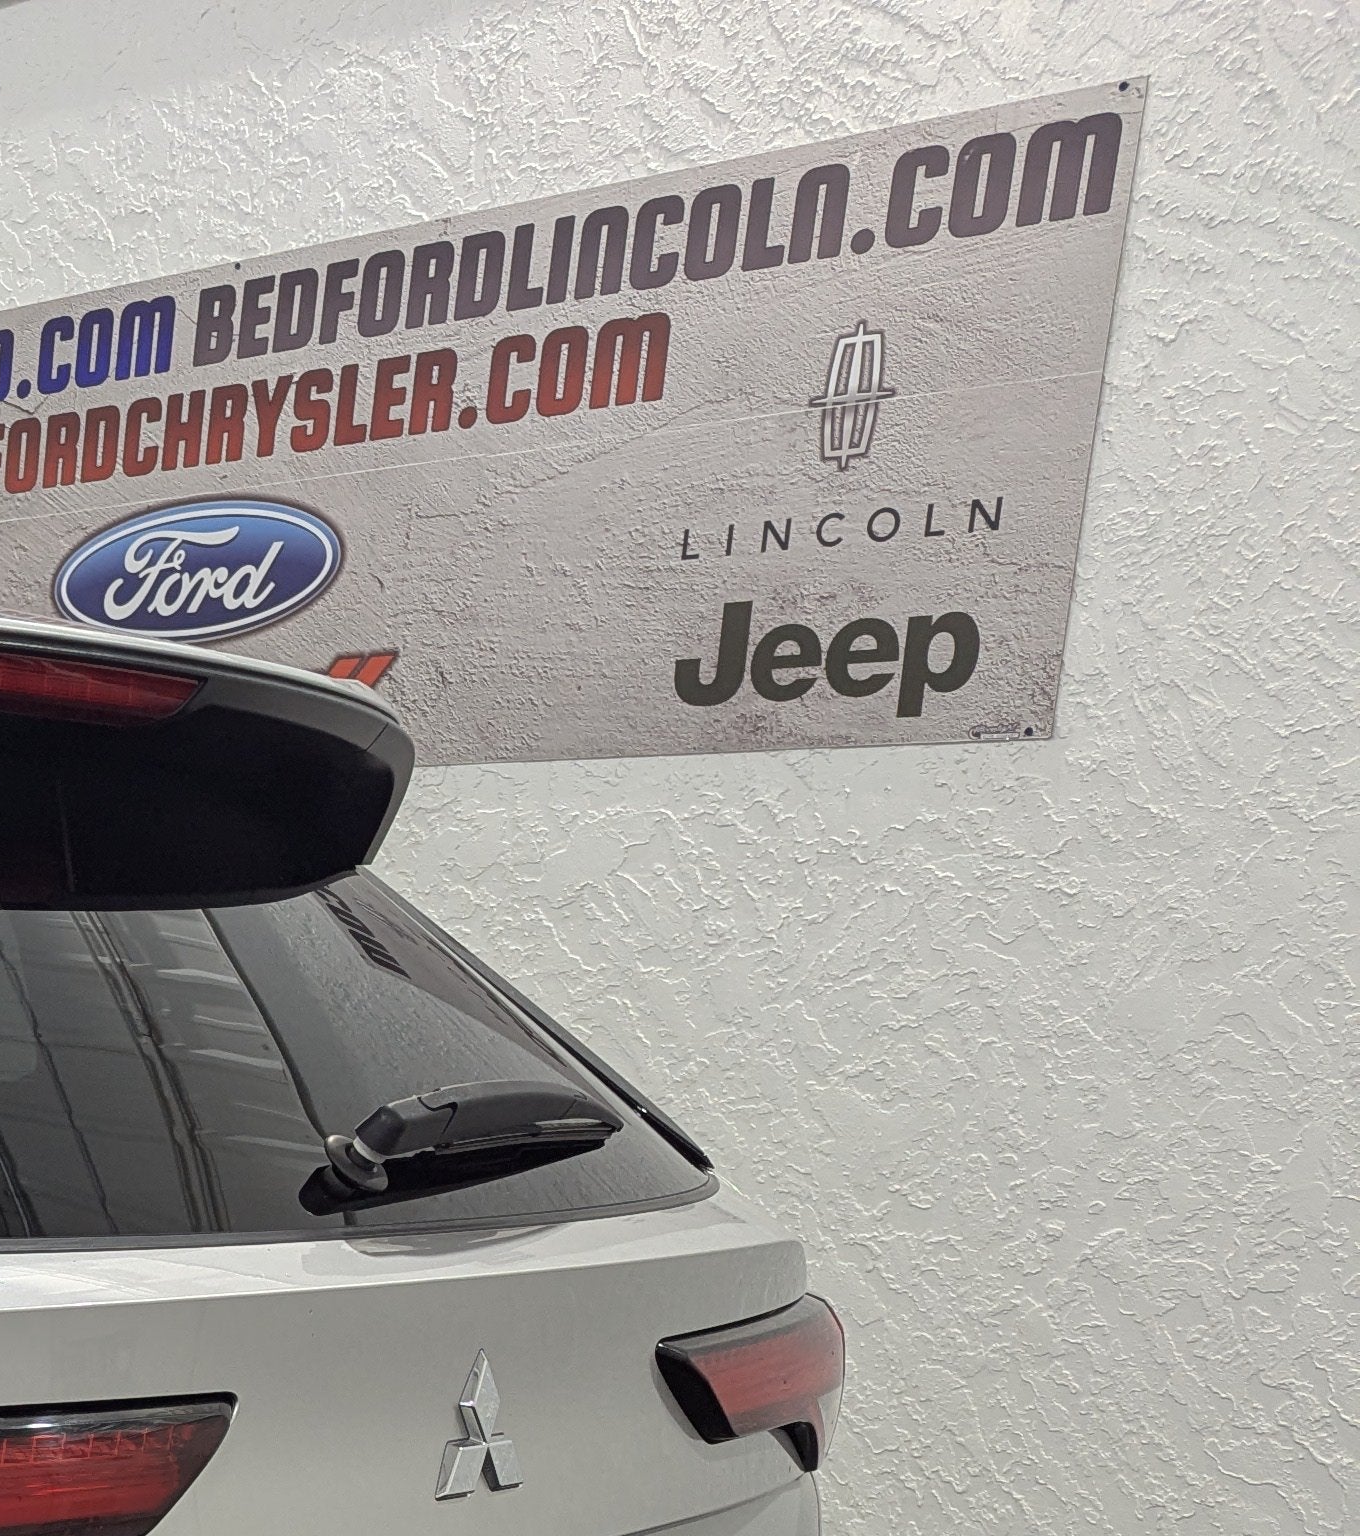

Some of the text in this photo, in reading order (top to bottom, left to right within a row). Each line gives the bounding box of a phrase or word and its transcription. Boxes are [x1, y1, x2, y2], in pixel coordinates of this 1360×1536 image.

[193, 111, 1123, 367] BEDFORDLINCOLN.COM
[102, 525, 285, 622] Ford
[681, 497, 1003, 560] LINCOLN
[674, 600, 980, 718] Jeep
